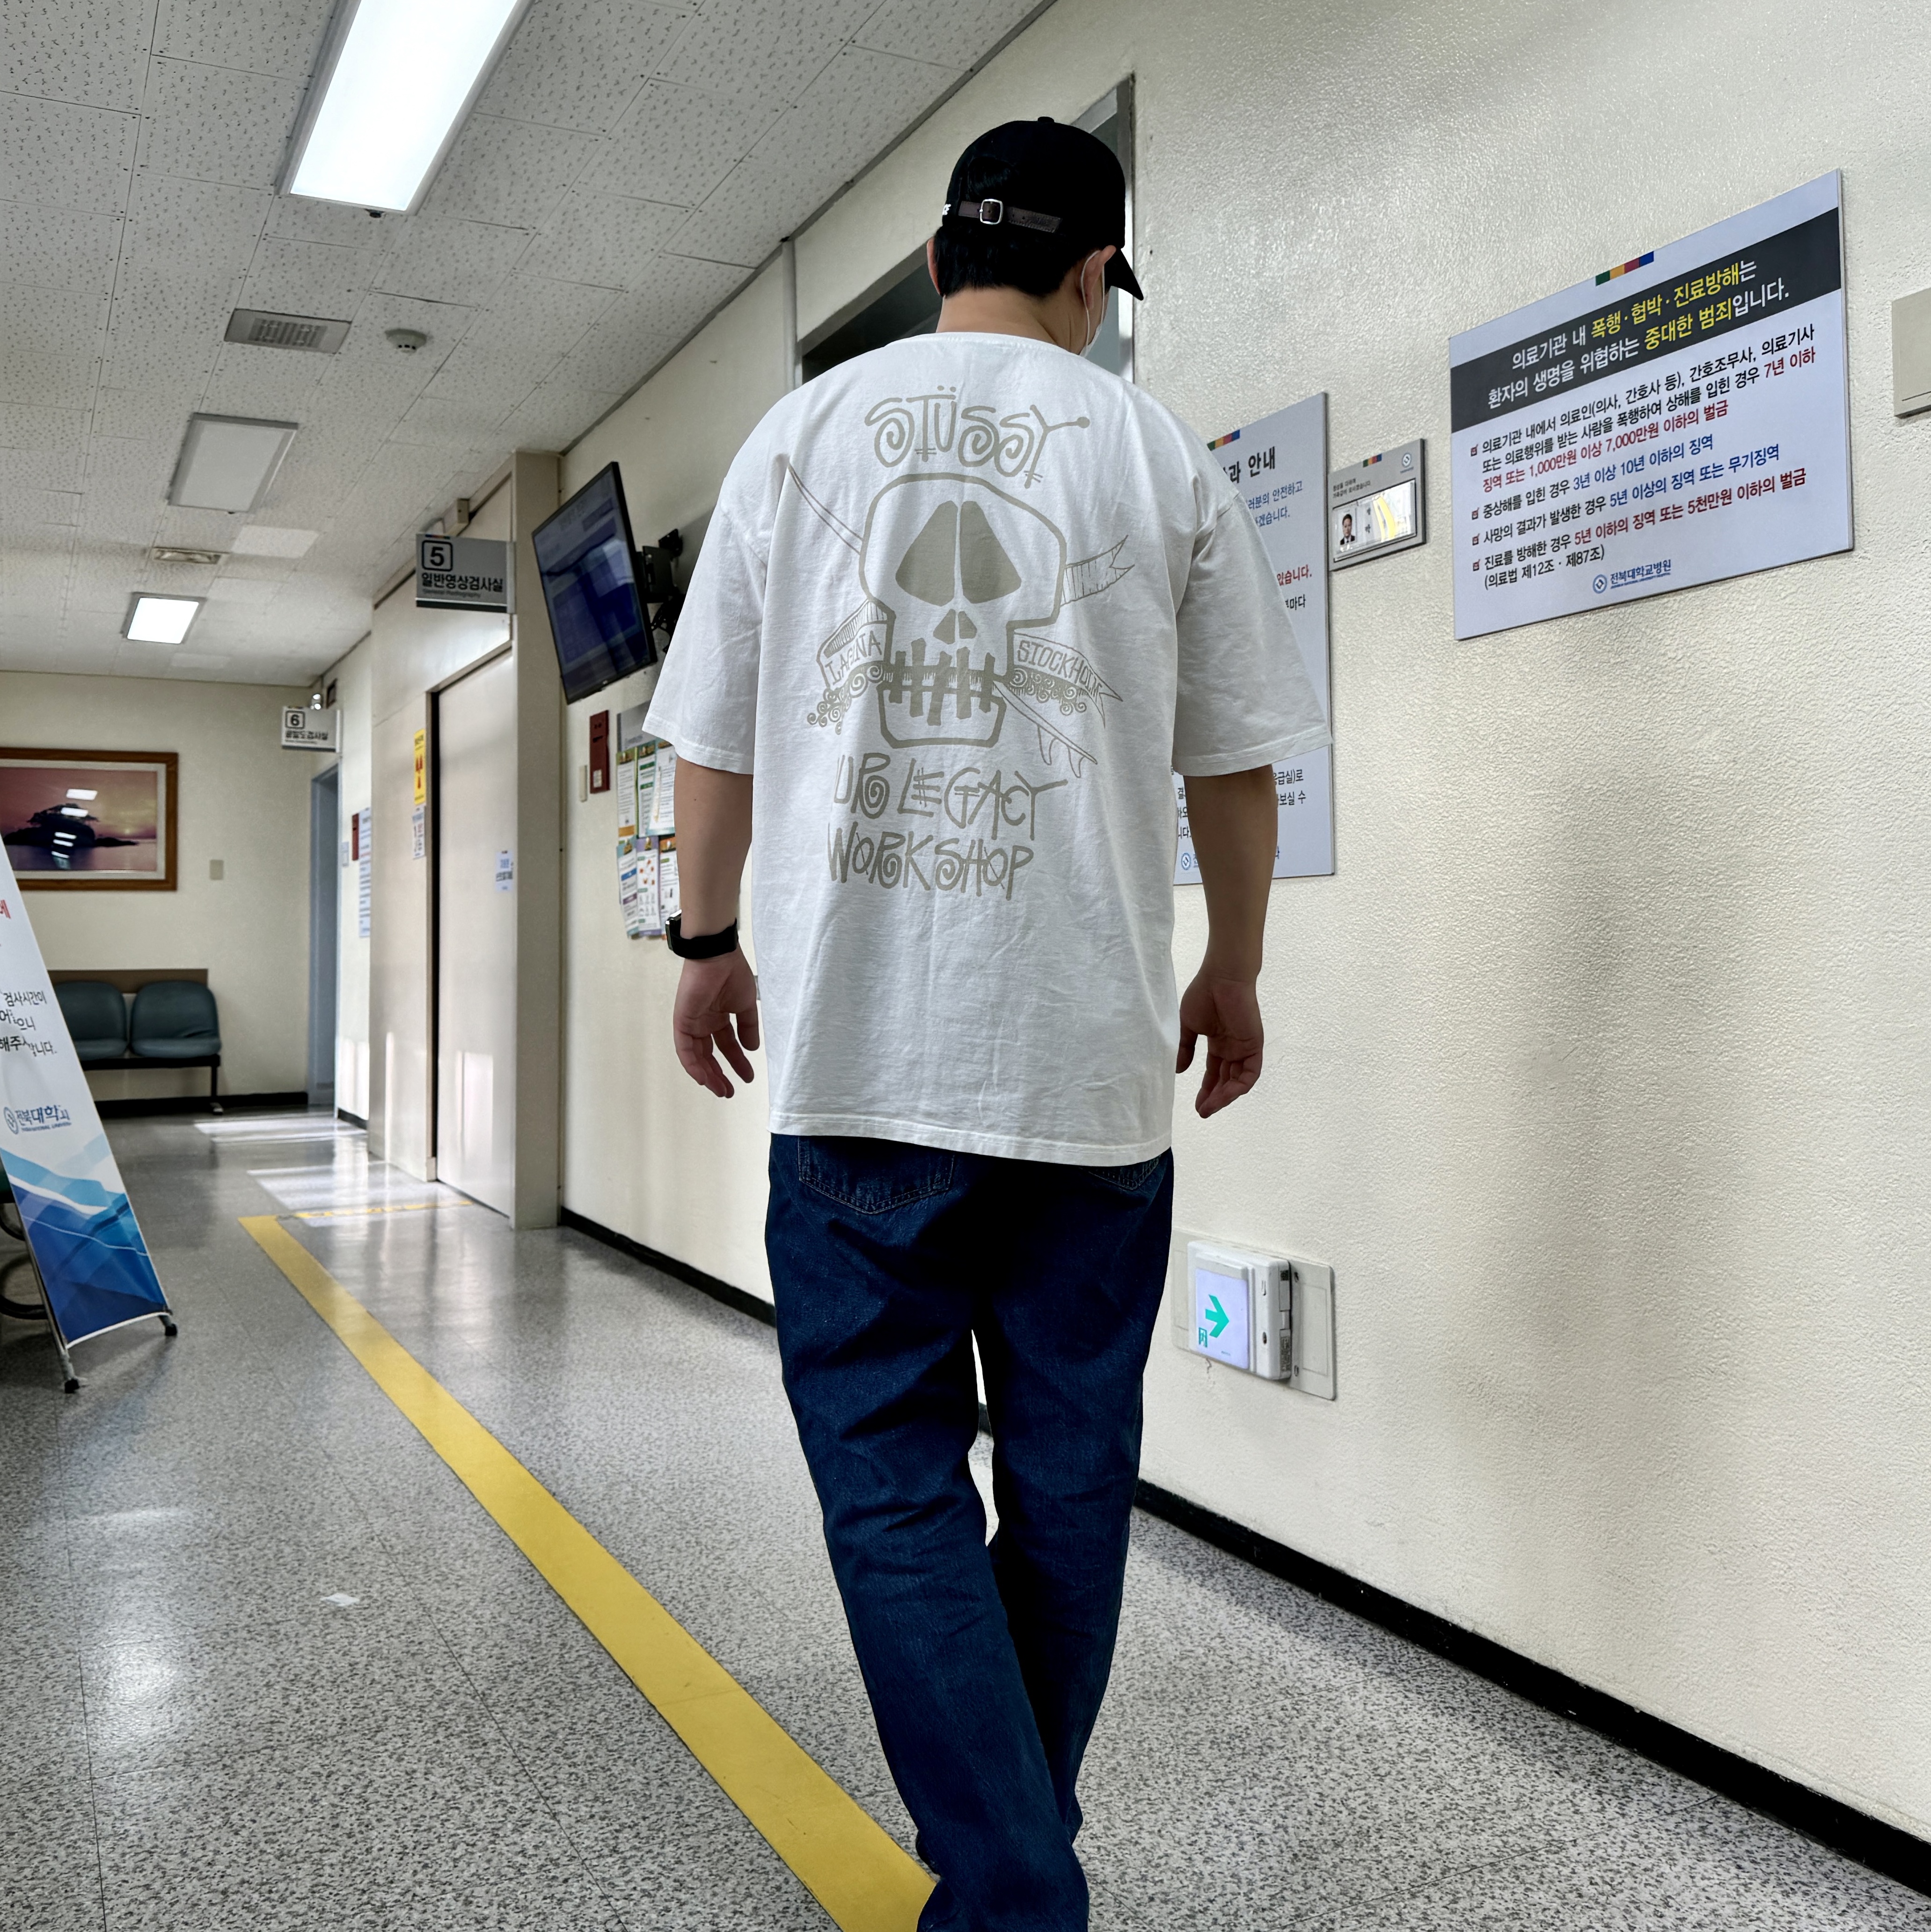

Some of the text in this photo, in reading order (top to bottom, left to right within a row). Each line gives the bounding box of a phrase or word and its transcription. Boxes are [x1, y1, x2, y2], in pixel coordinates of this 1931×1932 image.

[1488, 277, 1789, 409] 환자의 생명을 위협하는 중대한 범죄입니다.
[1512, 333, 1567, 369] 의료기관
[1573, 325, 1586, 346] 내
[1482, 323, 1814, 454] 의료기관 내에서 의료인(의사, 간호사 등), 간호조무사, 의료기사
[1482, 346, 1816, 474] 또는 의료행위를 받는 사람을 폭행하여 상해를 입힌 경우 7년 이하
[1223, 446, 1275, 483] 과 안내
[1483, 399, 1728, 493] 징역 또는 1,000만원 이상 7,000만원 이하의 벌금
[1246, 481, 1302, 510] 러분의 안전하고
[1483, 434, 1712, 519] 중상해를 입힌 경우 3년 이상 10년 이하의 징역
[1483, 443, 1779, 543] 사망의 결과가 발생한 경우 5년 이상의 징역 또는 무기징역
[1256, 506, 1290, 527] 겠습니다.
[1485, 468, 1807, 571] 진료를 방해한 경우 5년 이하의 징역 또는 5천만원 이하의 벌금
[430, 546, 445, 567] 5
[1277, 564, 1312, 586] 있습니다.
[1485, 568, 1517, 590] (의료법
[1521, 559, 1555, 578] 제12조
[1565, 544, 1604, 567] 제87조)
[1610, 559, 1671, 584] 전북대학교병원
[422, 572, 504, 593] 일반영상검사실
[1017, 639, 1103, 702] STOCKHOLM
[290, 714, 300, 726] 6
[897, 758, 1068, 840] LEGACY
[1277, 790, 1306, 805] 보실 수
